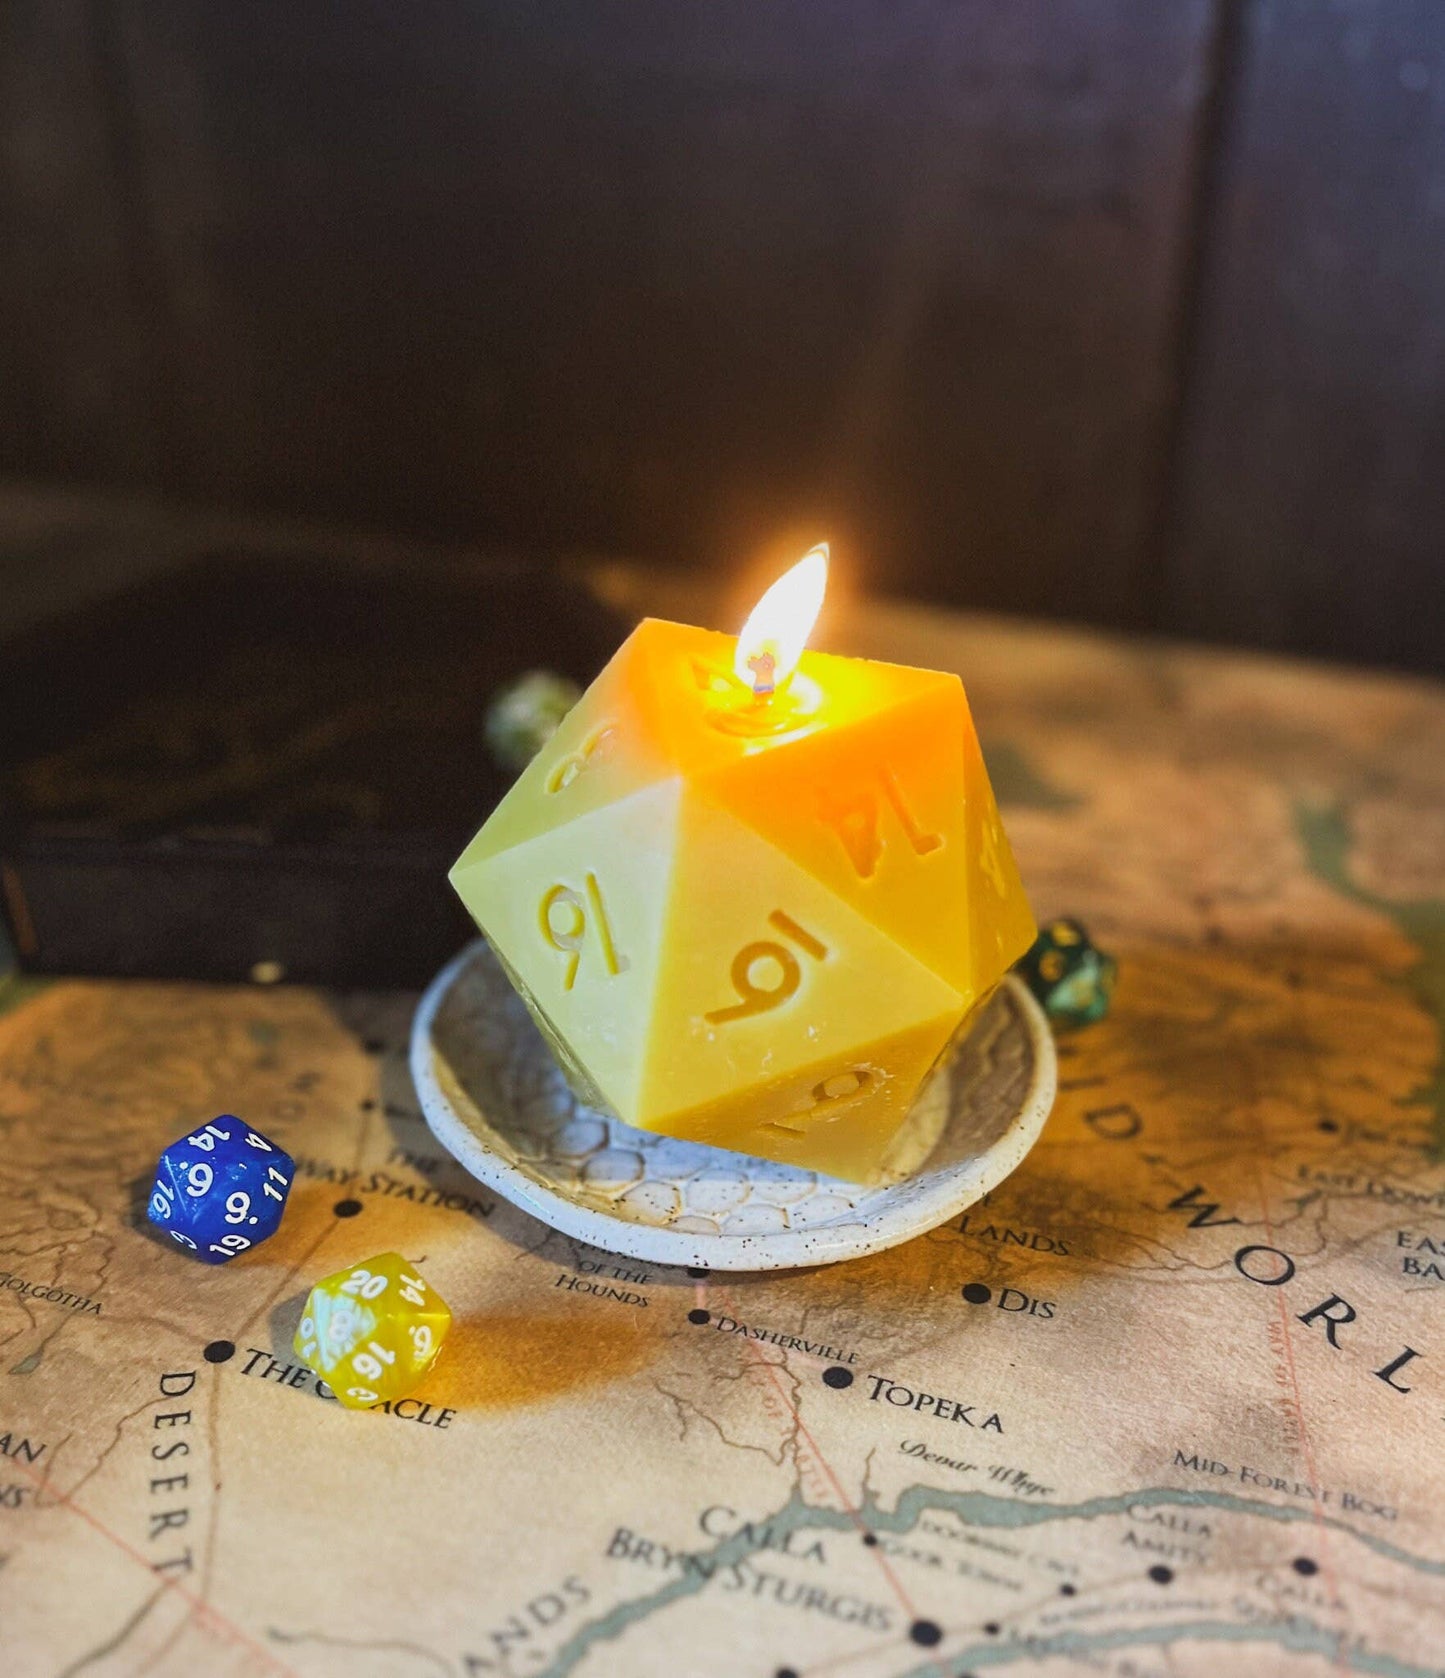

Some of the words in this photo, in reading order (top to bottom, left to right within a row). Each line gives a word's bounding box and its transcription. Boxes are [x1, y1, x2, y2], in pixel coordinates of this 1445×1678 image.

[537, 871, 629, 991] 16
[187, 1125, 230, 1152] 14
[245, 1132, 273, 1152] 4
[152, 1179, 175, 1219] 16
[263, 1166, 288, 1201] 11
[361, 1171, 497, 1218] STATION
[209, 1234, 251, 1257] 19
[958, 1214, 1073, 1257] LANDS
[340, 1269, 388, 1300] 20
[399, 1273, 426, 1307] 14
[555, 1274, 649, 1308] HOUNDS
[579, 1260, 607, 1275] OF
[613, 1266, 653, 1285] THE
[1169, 1185, 1425, 1395] WORL
[998, 1287, 1057, 1319] DIS
[716, 1316, 860, 1365] DASHERVILLE
[352, 1341, 396, 1381] 16
[240, 1348, 312, 1389] THE
[315, 1378, 458, 1430] OACLE
[867, 1374, 1004, 1434] TOPEKA
[149, 1371, 197, 1573] DESERT
[1126, 1503, 1212, 1538] CALLA
[1341, 1492, 1398, 1521] BOG
[700, 1505, 827, 1564] CALLA
[605, 1526, 716, 1579] BRYN
[721, 1563, 892, 1630] STURGIS
